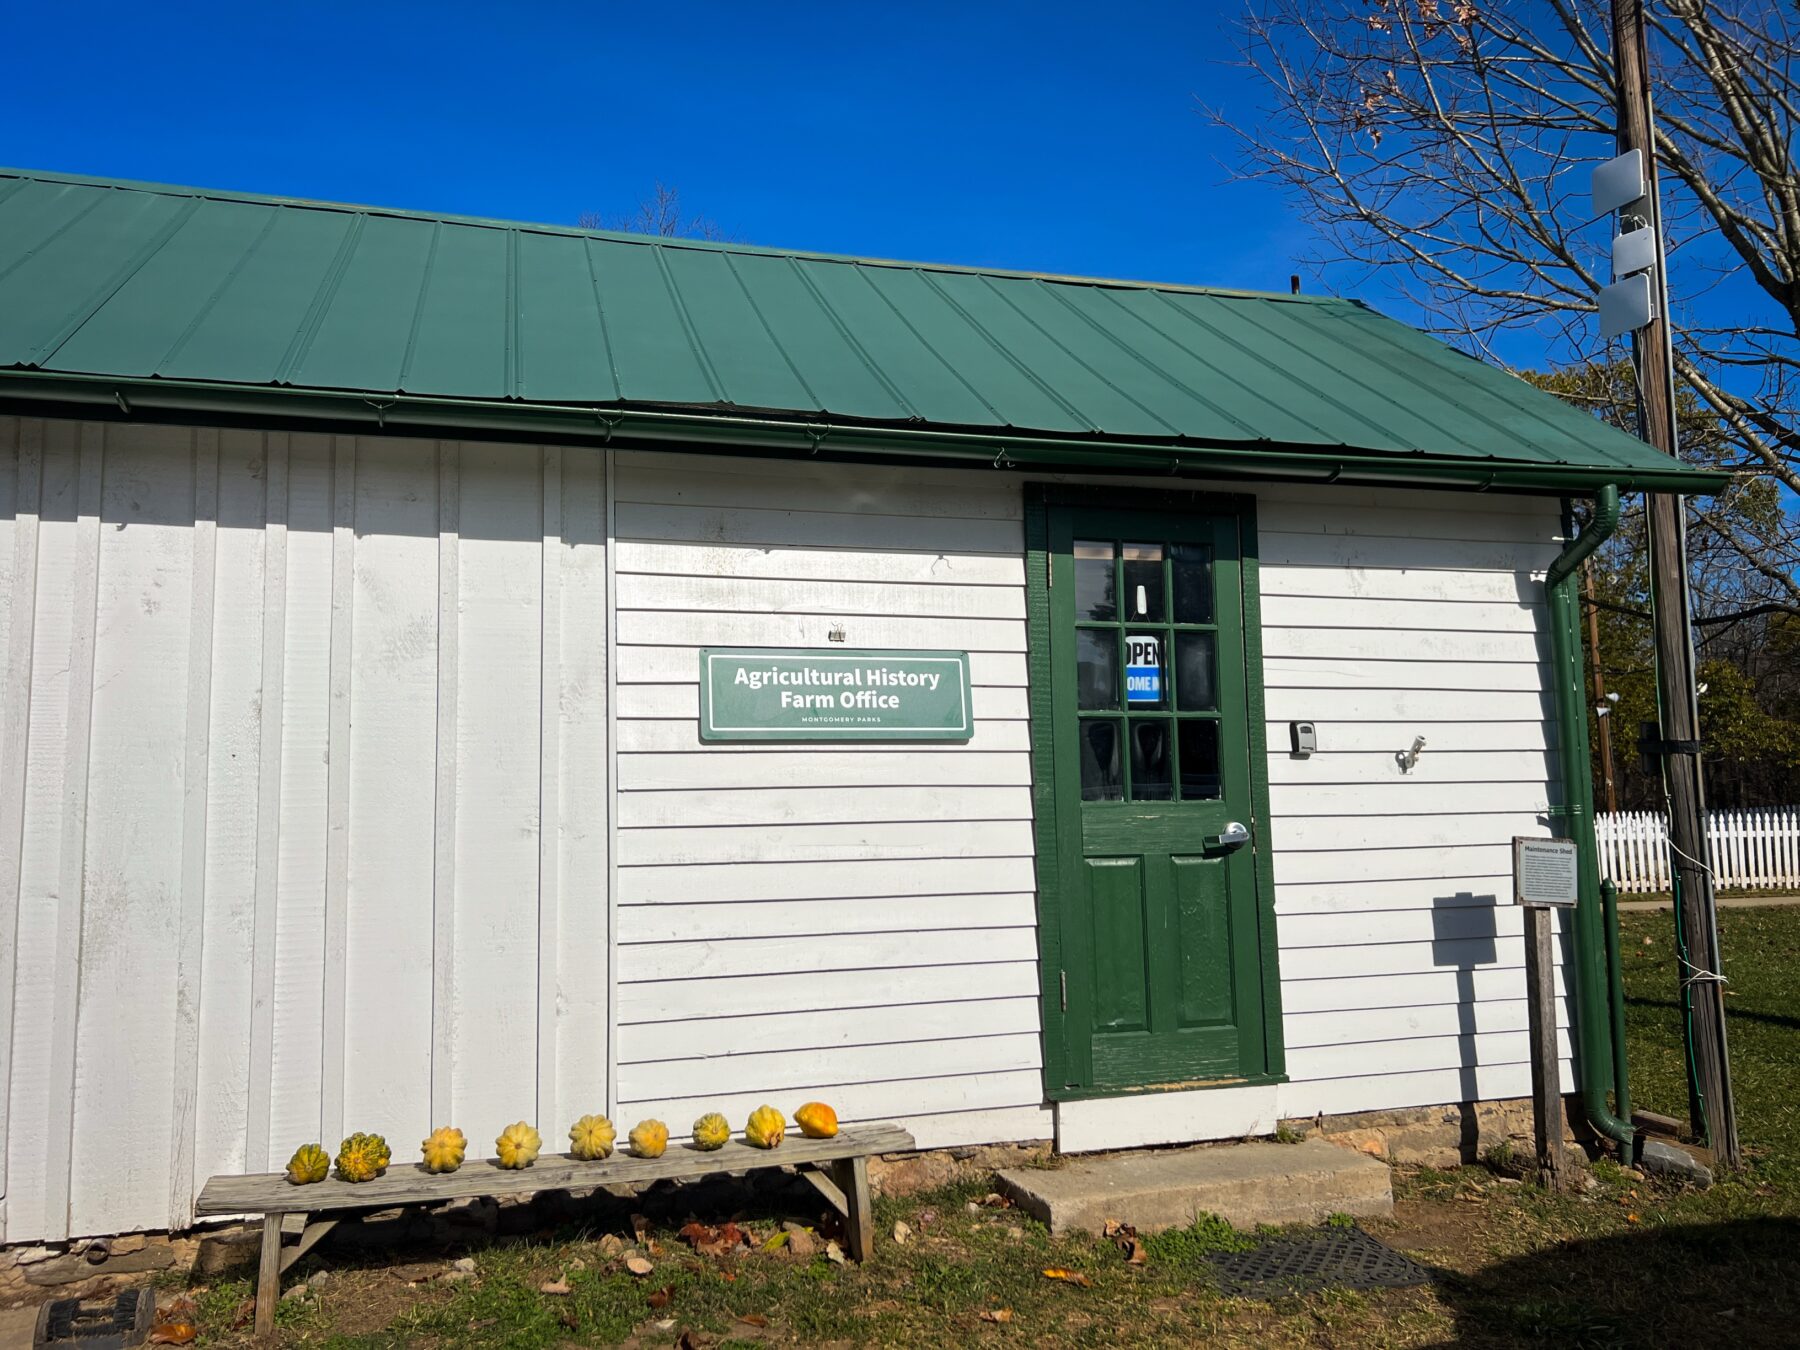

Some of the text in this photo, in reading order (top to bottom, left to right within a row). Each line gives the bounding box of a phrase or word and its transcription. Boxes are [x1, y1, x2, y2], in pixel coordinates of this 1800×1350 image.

[734, 666, 940, 690] Agricultural History
[1127, 676, 1151, 691] OME
[781, 690, 900, 709] Farm Office
[1525, 846, 1558, 854] Maintenance
